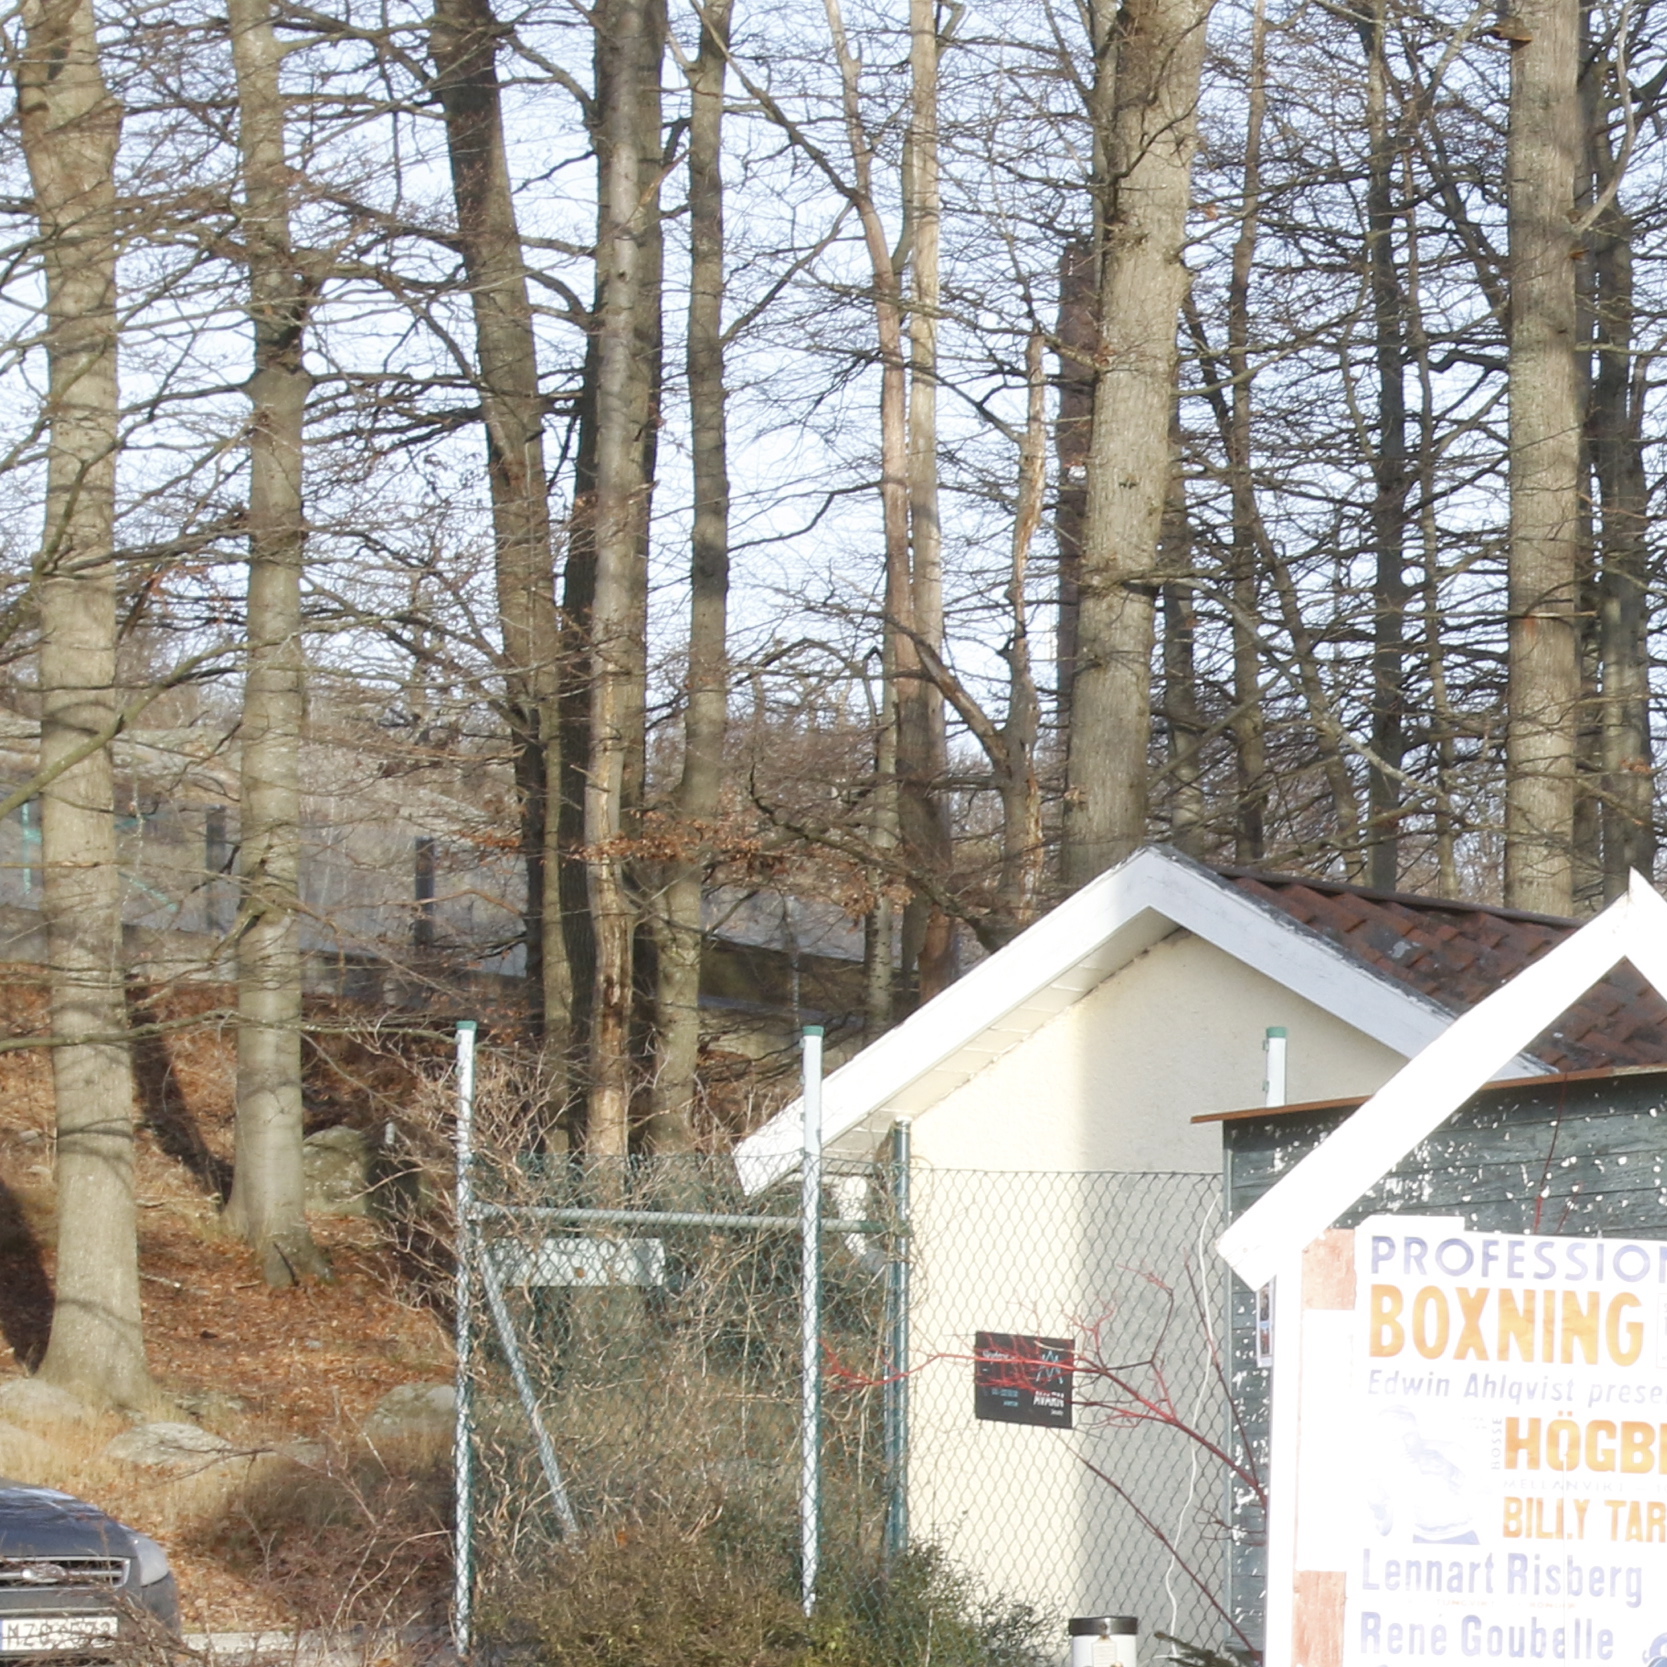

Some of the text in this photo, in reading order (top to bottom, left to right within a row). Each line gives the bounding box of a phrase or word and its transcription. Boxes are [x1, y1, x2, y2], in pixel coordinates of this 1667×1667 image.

[1368, 1283, 1645, 1367] BOXNING
[1367, 1369, 1450, 1399] Edwin
[1463, 1372, 1575, 1402] Ahlqvist
[1503, 1496, 1590, 1540] BILLY
[1361, 1548, 1643, 1609] Lennart Risberg
[1460, 1613, 1614, 1661] Goubelle
